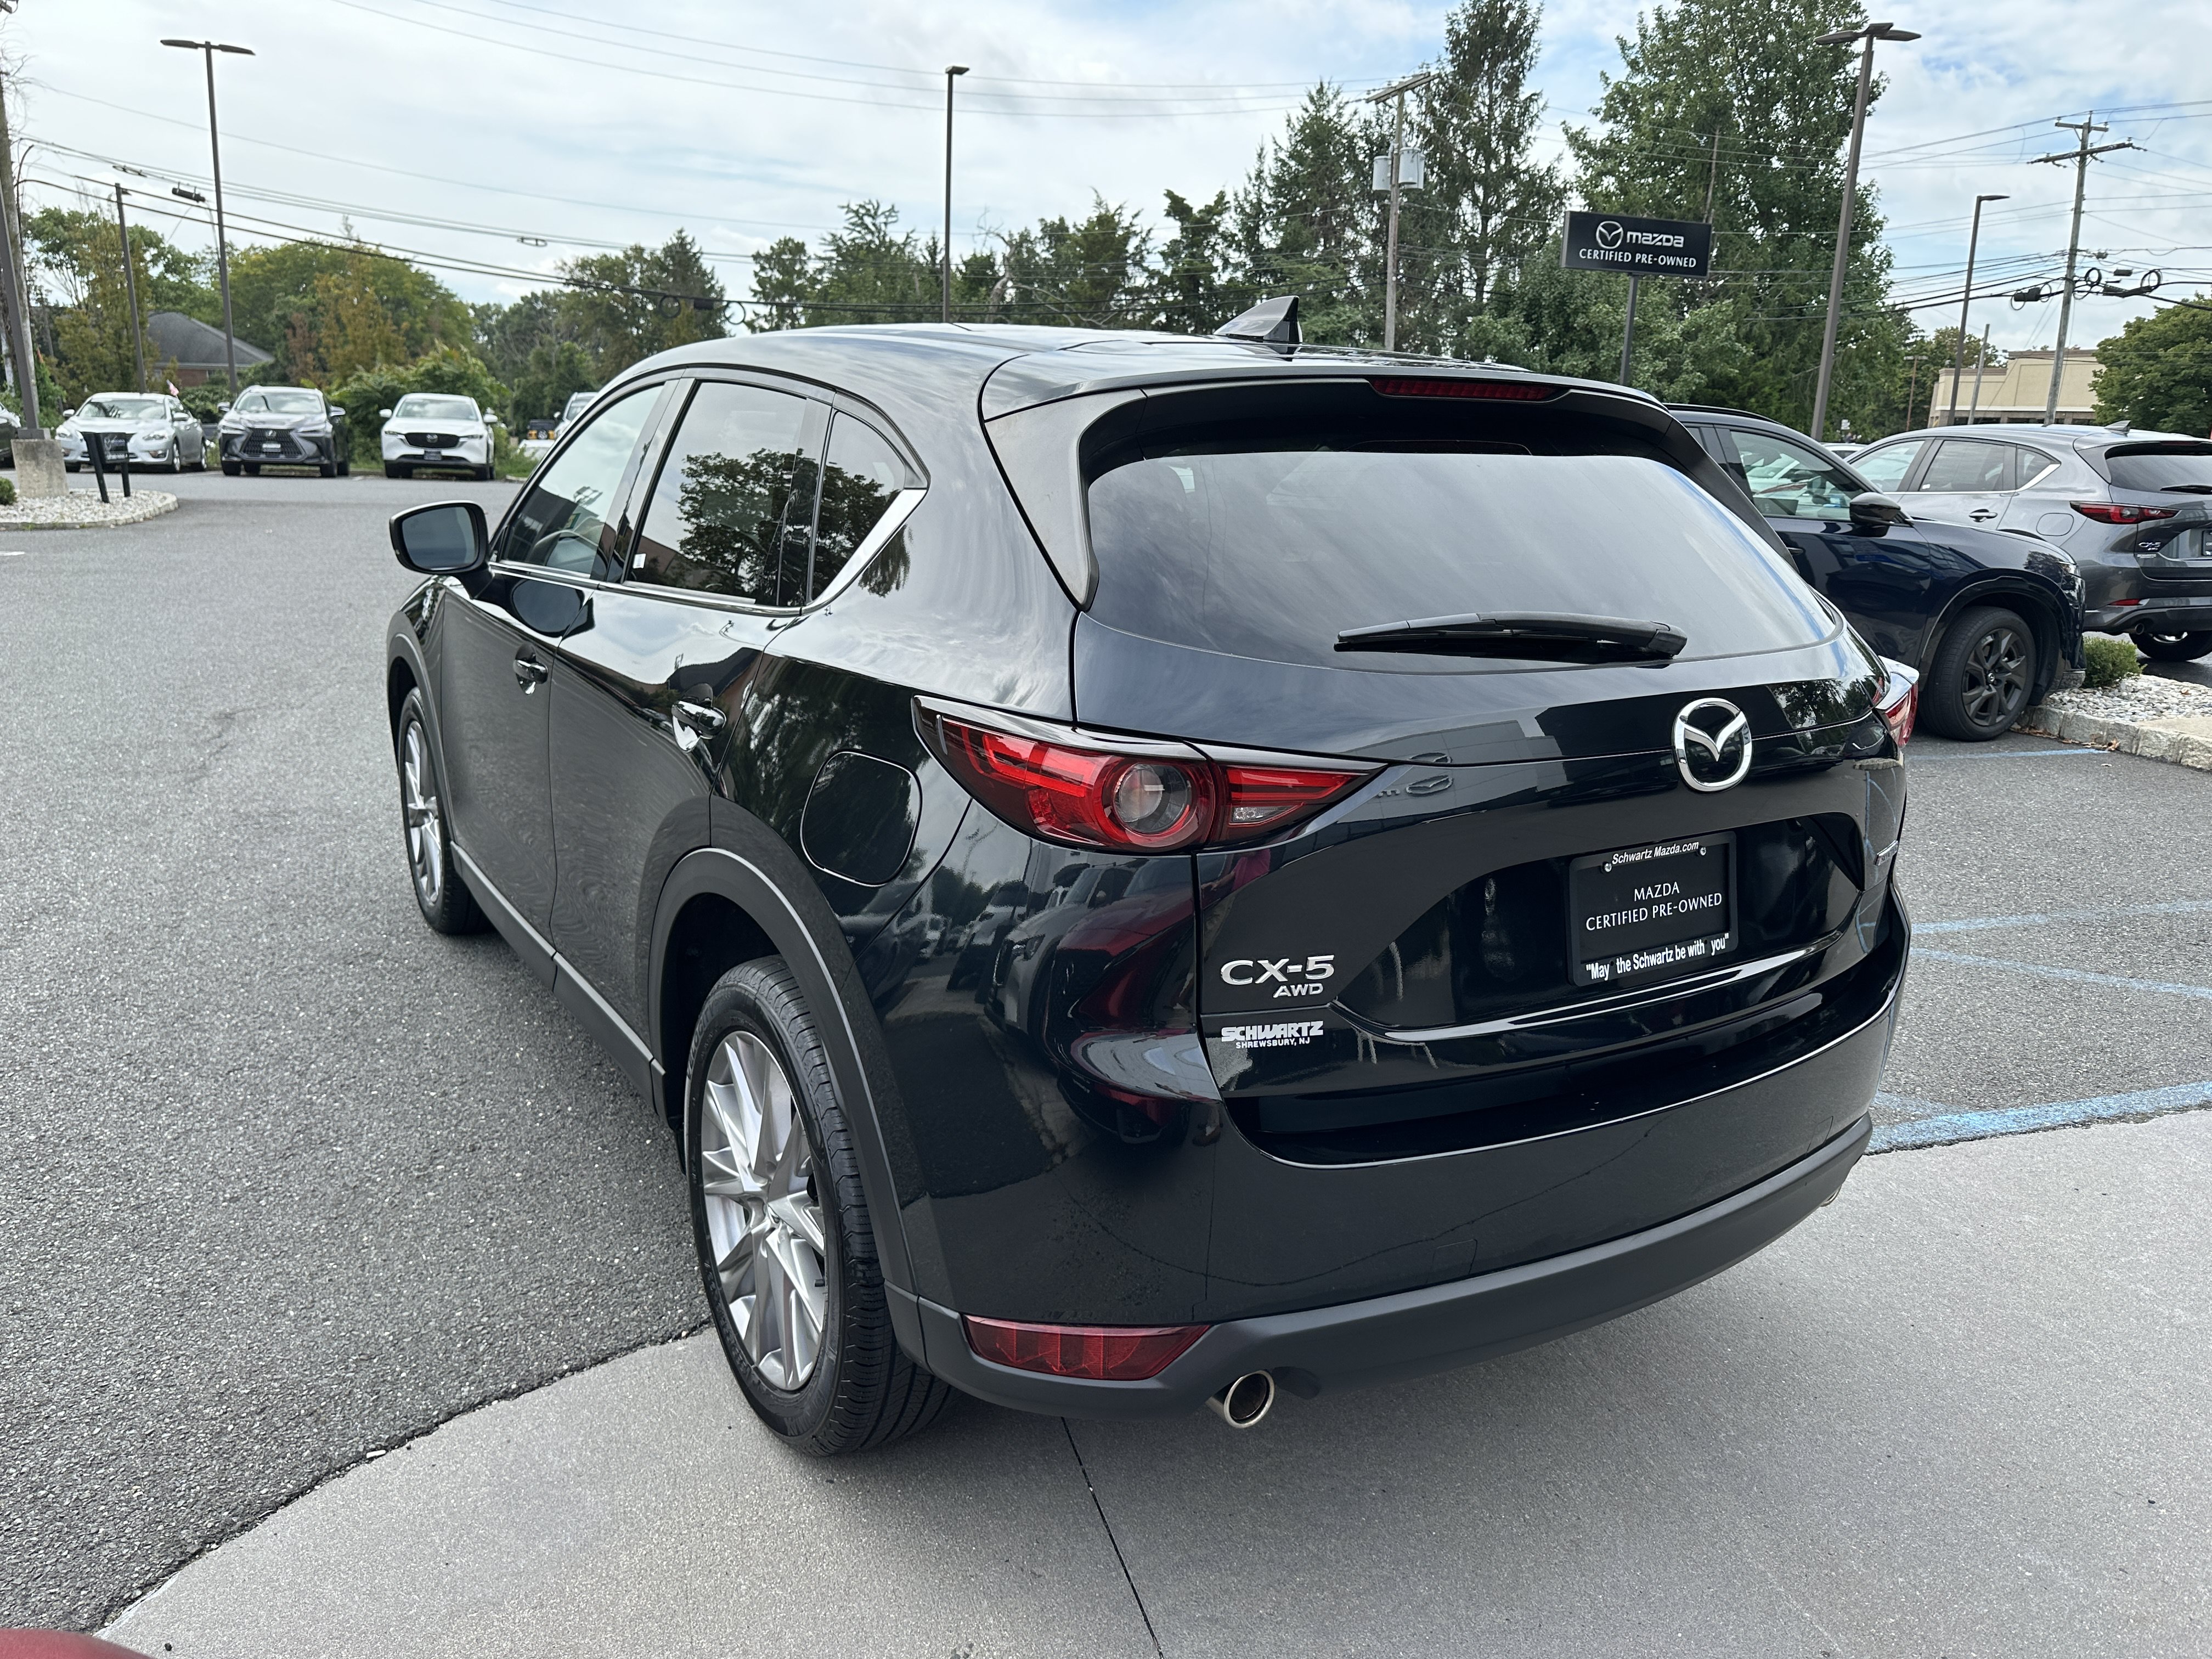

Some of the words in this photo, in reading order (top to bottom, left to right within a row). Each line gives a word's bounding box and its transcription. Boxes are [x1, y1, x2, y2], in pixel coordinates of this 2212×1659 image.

[1579, 249, 1632, 263] CERTIFIED
[1635, 253, 1696, 268] PRE-OWNED
[1612, 849, 1652, 865] Schwartz
[1654, 841, 1699, 857] Mazda.com
[1634, 882, 1680, 901] MAZDA
[1585, 907, 1648, 931] CERTIFIED
[1652, 893, 1722, 918] PRE-OWNED
[1585, 962, 1610, 981] "May
[1616, 957, 1632, 974] the
[1633, 947, 1674, 970] Schwartz
[1675, 945, 1686, 961] be
[1687, 940, 1705, 957] with
[1710, 933, 1729, 956] you"
[1221, 955, 1335, 985] CX-5
[1273, 983, 1323, 998] AWD
[1221, 1020, 1323, 1042] SCHWARTZ
[1235, 1037, 1297, 1049] SHREWSBURY,
[1299, 1036, 1310, 1045] NJ
